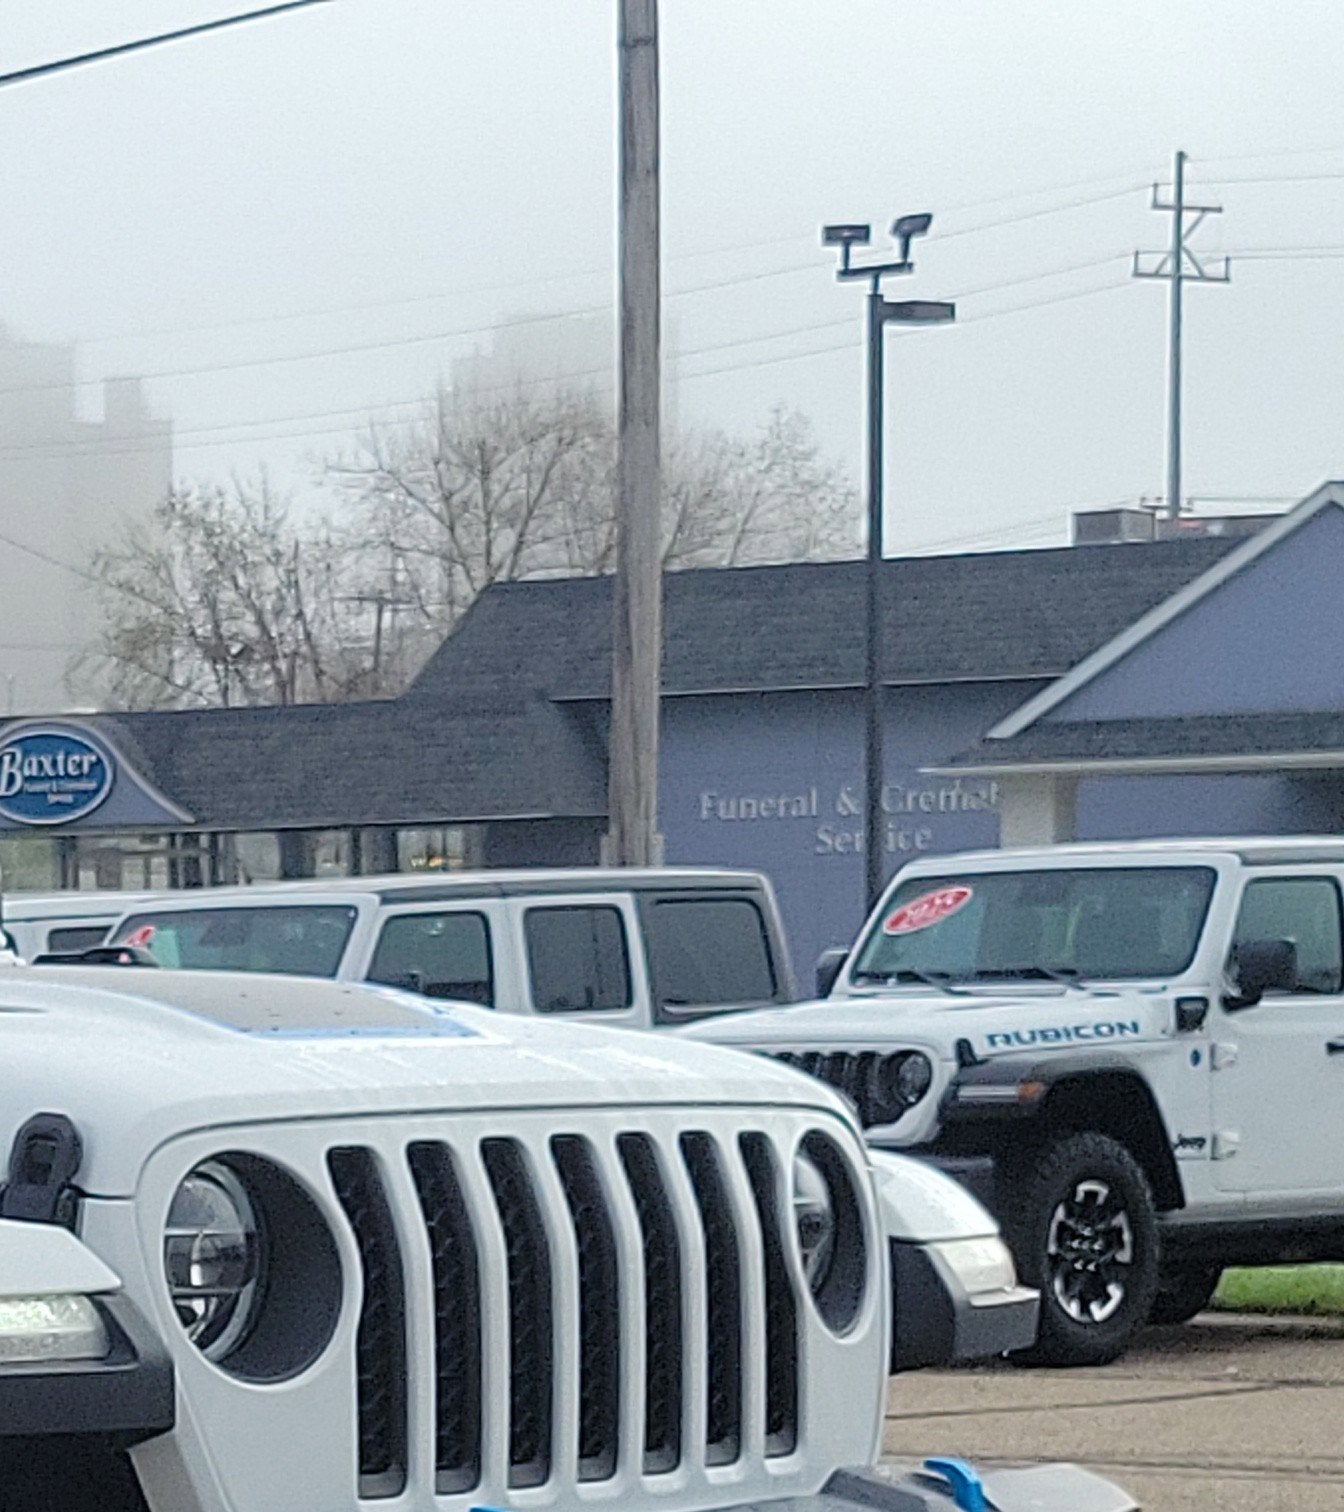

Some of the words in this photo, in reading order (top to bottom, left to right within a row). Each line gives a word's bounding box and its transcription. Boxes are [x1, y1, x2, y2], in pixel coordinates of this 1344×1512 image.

[699, 786, 818, 820] Funeral
[816, 822, 932, 854] Serice
[986, 1021, 1140, 1047] RUBICON
